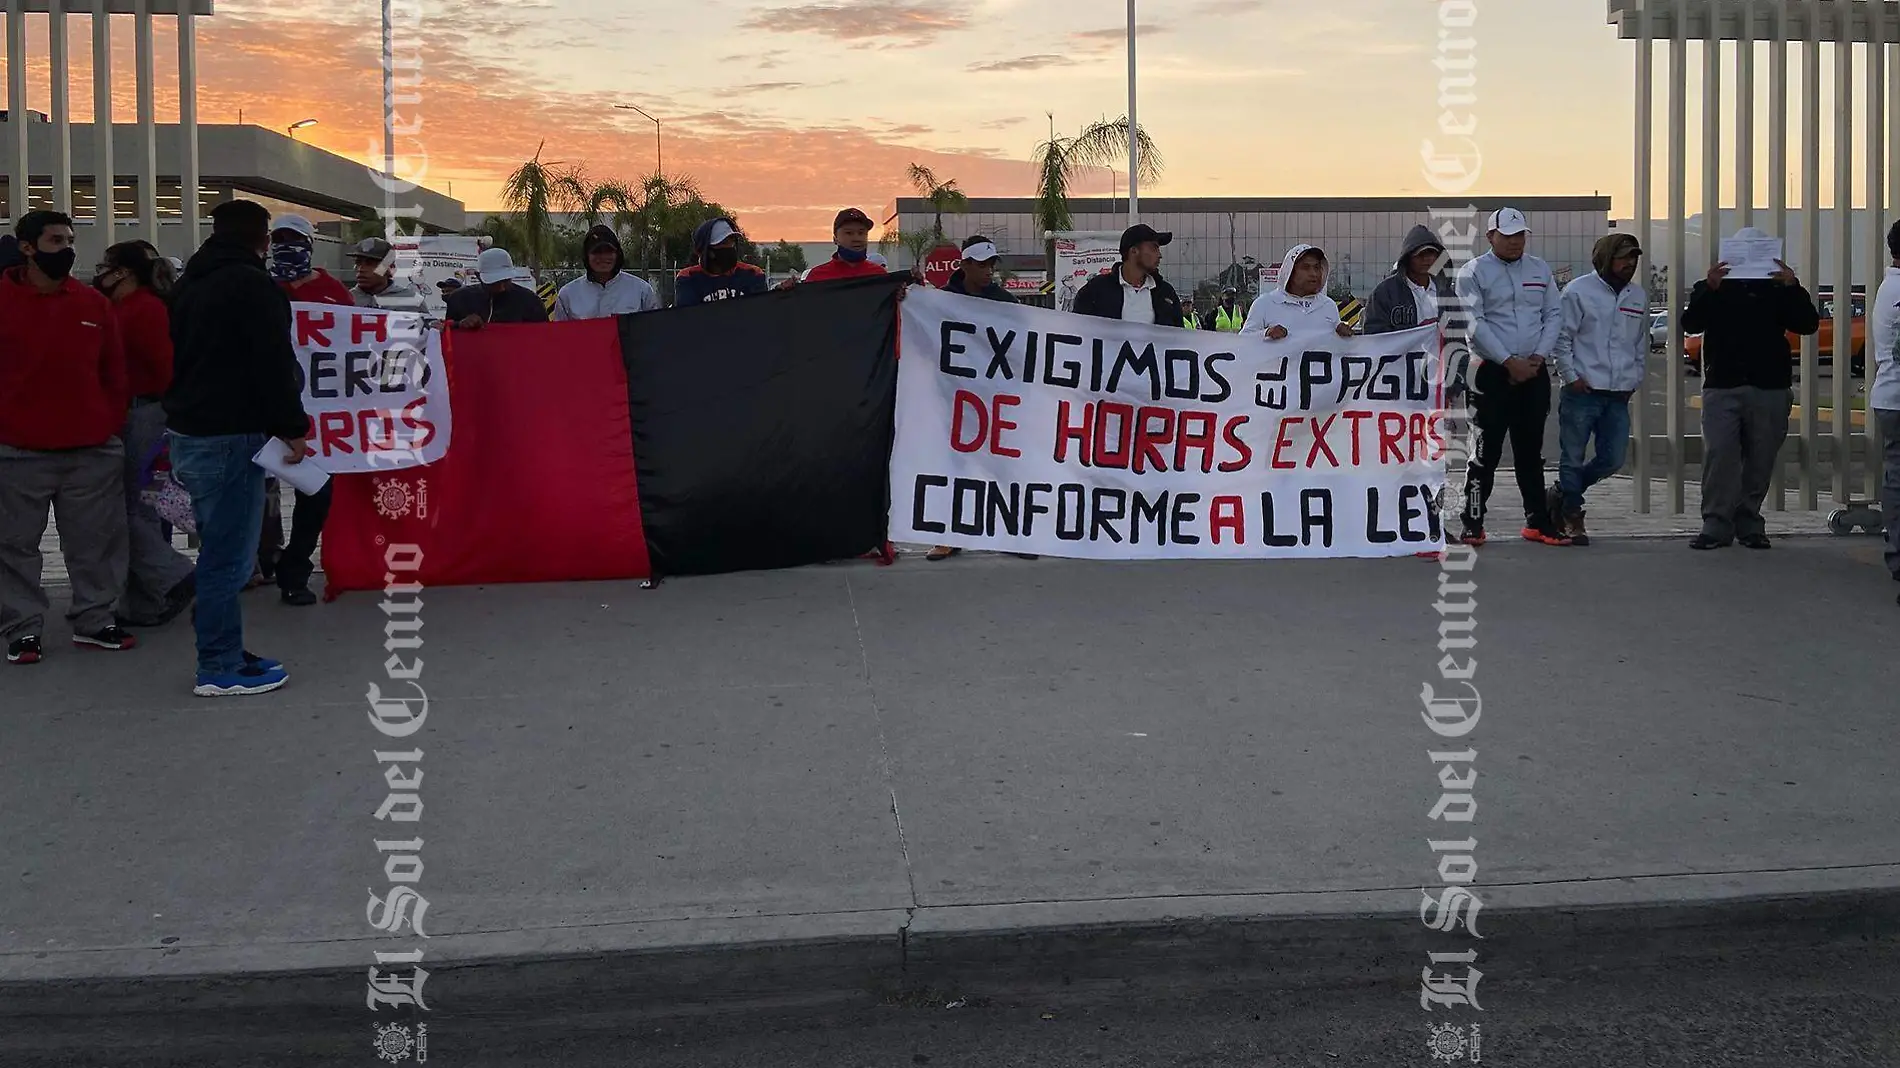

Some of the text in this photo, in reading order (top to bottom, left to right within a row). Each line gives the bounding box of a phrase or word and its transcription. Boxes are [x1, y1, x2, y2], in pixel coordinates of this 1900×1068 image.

[412, 259, 464, 268] Sna Distancia
[1087, 256, 1116, 264] Distancia
[940, 321, 1429, 410] EXIGIMOS EL PAGO
[950, 389, 1446, 475] DE HORAS EXTRAS
[912, 473, 1200, 546] CONFORME
[1209, 495, 1245, 545] A
[1261, 488, 1333, 547] LA
